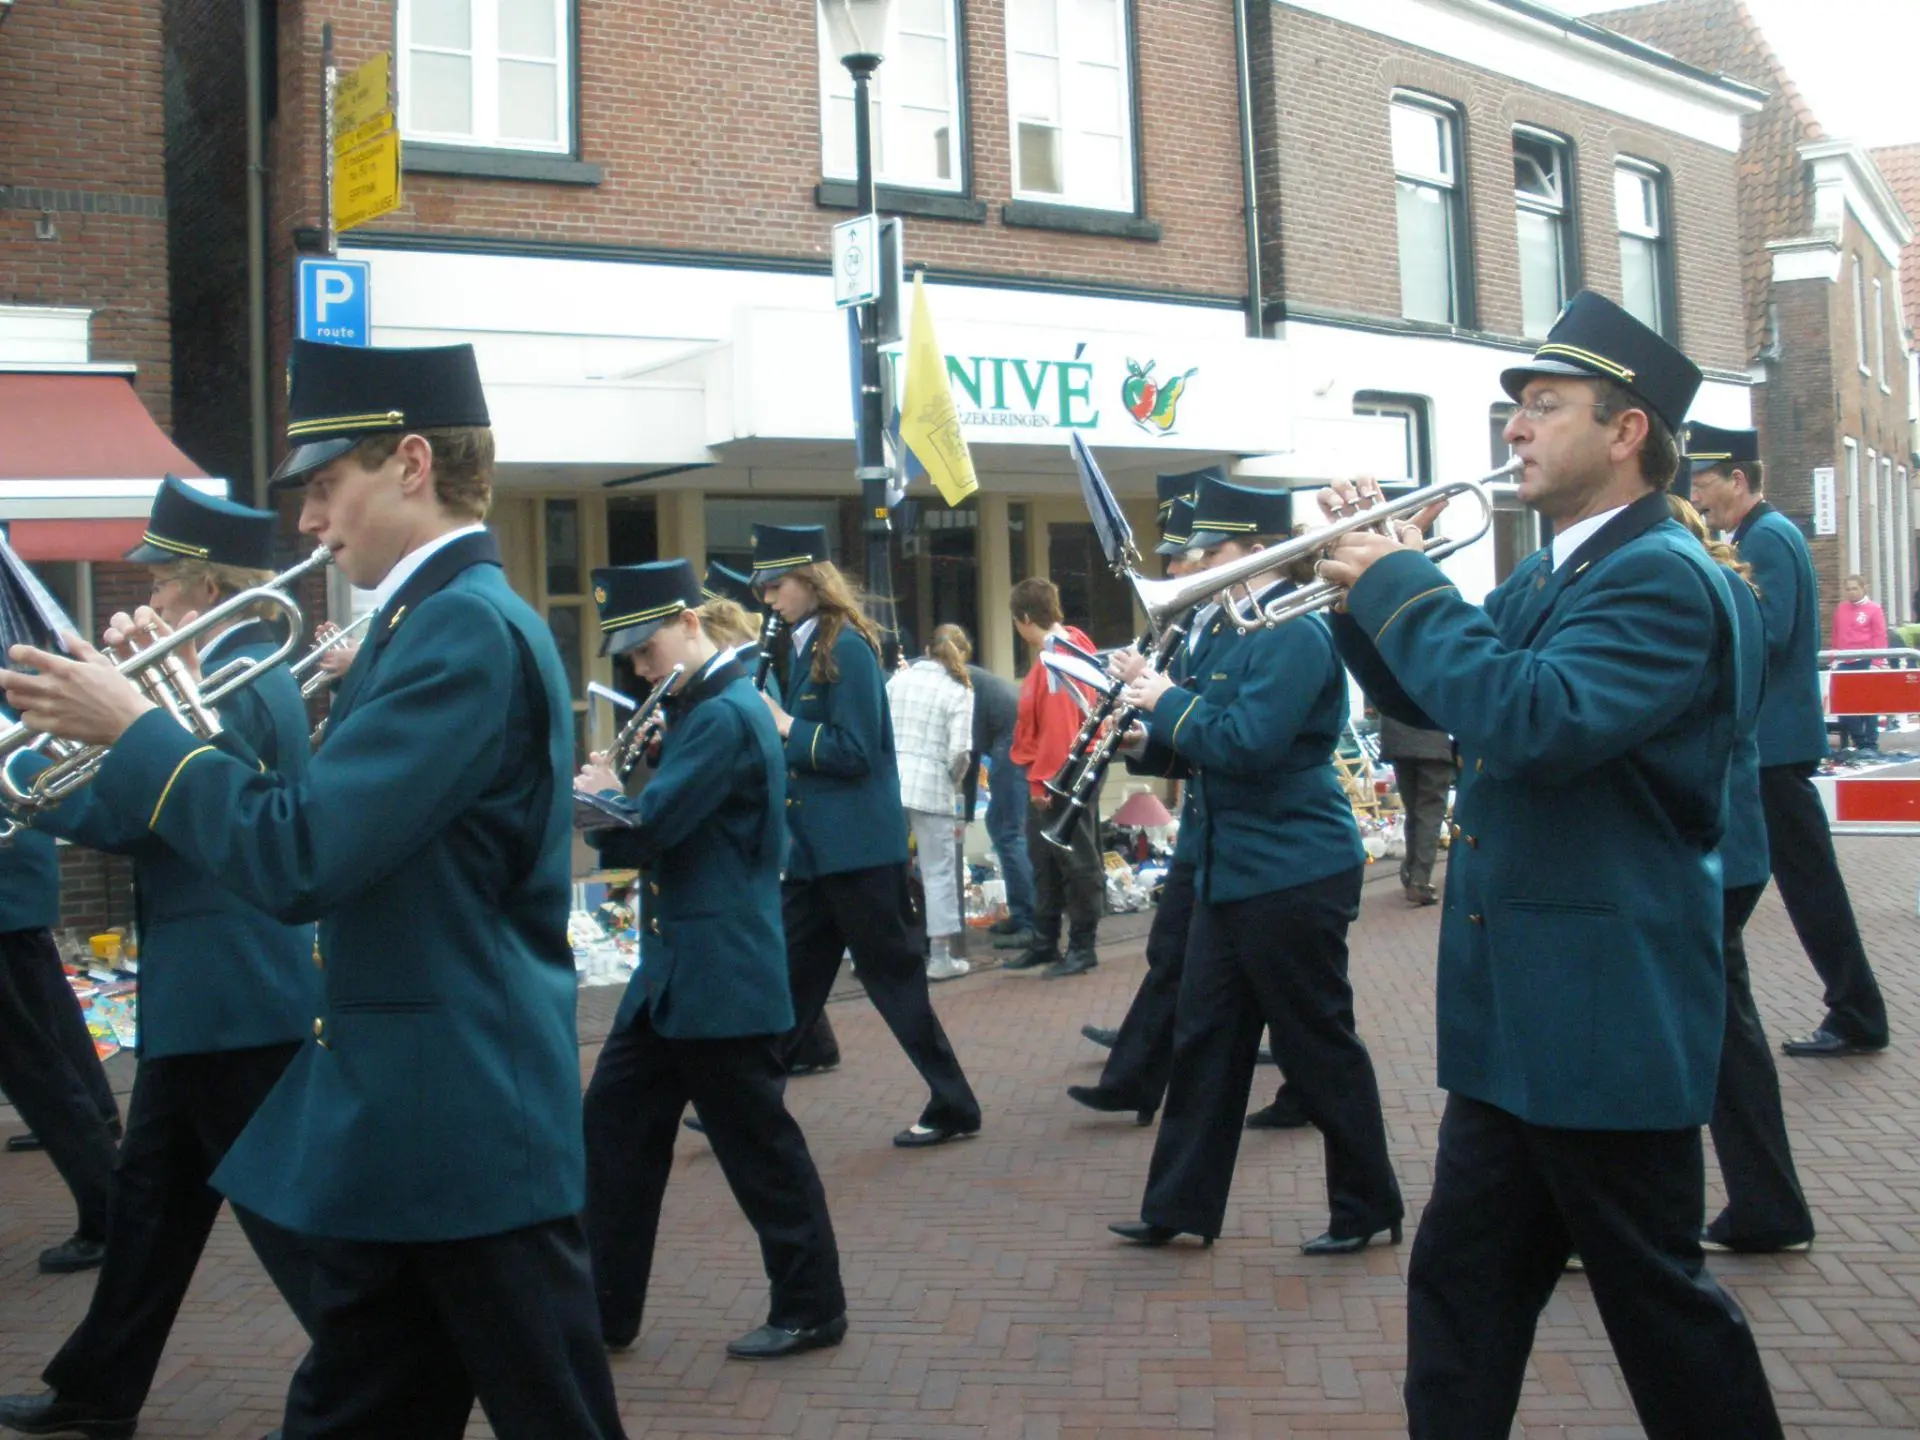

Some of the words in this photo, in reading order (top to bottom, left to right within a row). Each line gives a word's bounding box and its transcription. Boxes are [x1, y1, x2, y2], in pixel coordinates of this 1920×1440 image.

[316, 269, 353, 322] P
[317, 327, 354, 338] route
[960, 411, 1050, 428] ZEKERINGEN
